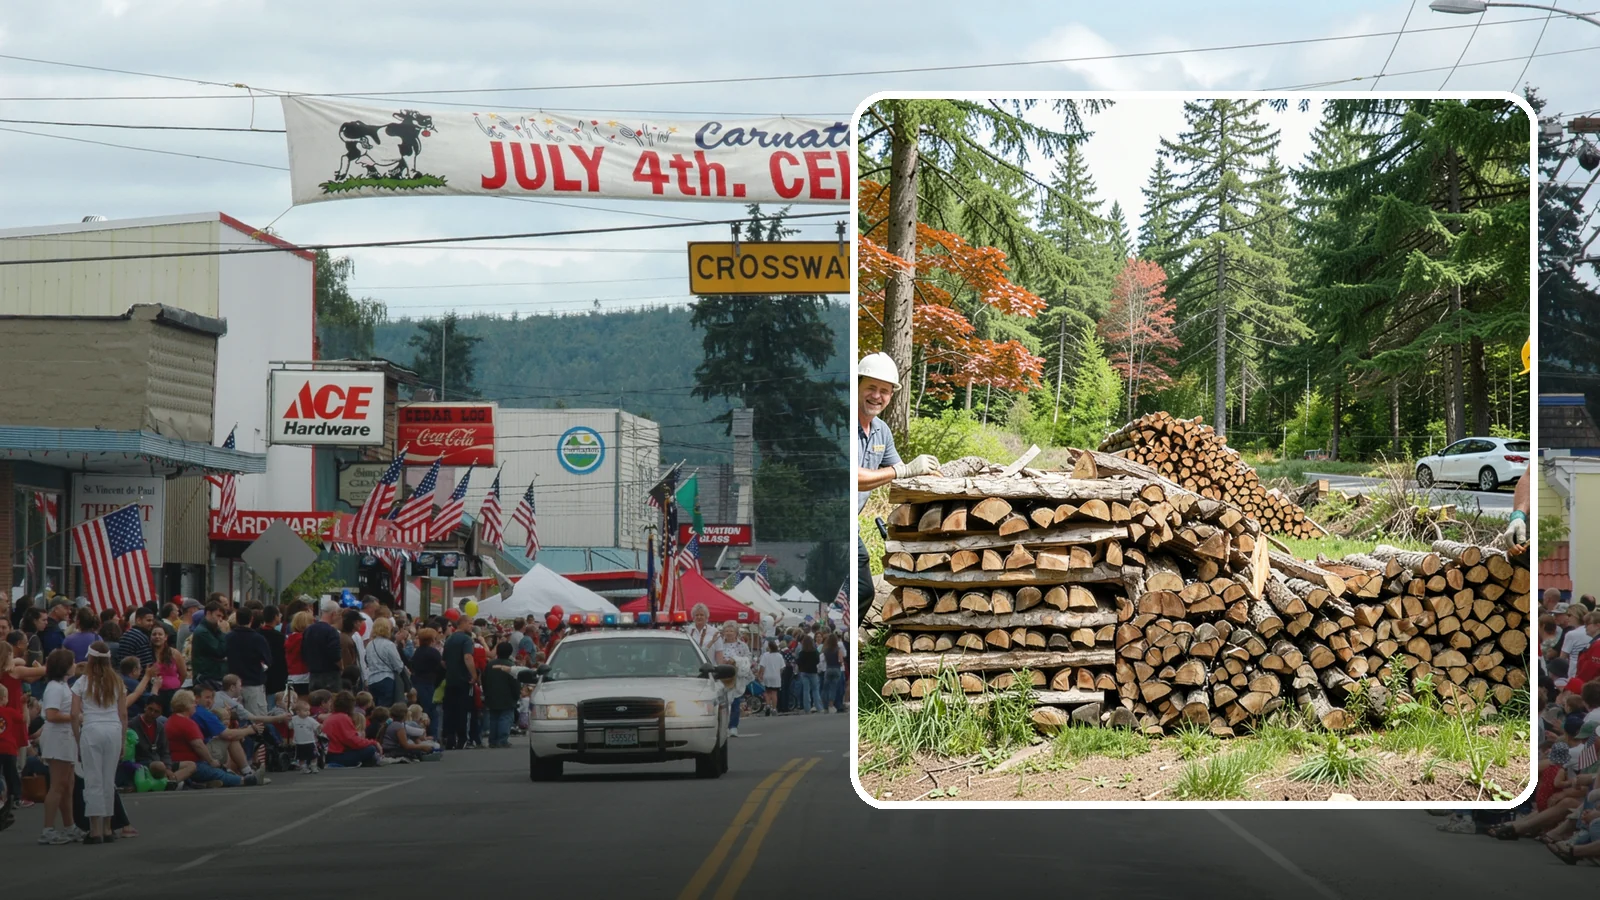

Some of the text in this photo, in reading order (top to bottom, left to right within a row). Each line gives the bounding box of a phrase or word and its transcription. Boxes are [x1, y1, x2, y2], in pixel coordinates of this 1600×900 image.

[695, 121, 850, 149] Carnat
[481, 141, 604, 192] JULY
[632, 150, 746, 197] 4th.
[697, 254, 850, 280] CROSSWA
[283, 380, 373, 420] ACE
[406, 409, 452, 422] CEDAR
[284, 421, 370, 436] Hardware
[416, 428, 476, 446] Coca-Cola
[83, 485, 155, 495] St. Vincent de Paul
[688, 526, 741, 535] CRNATION
[699, 535, 730, 544] GLASS
